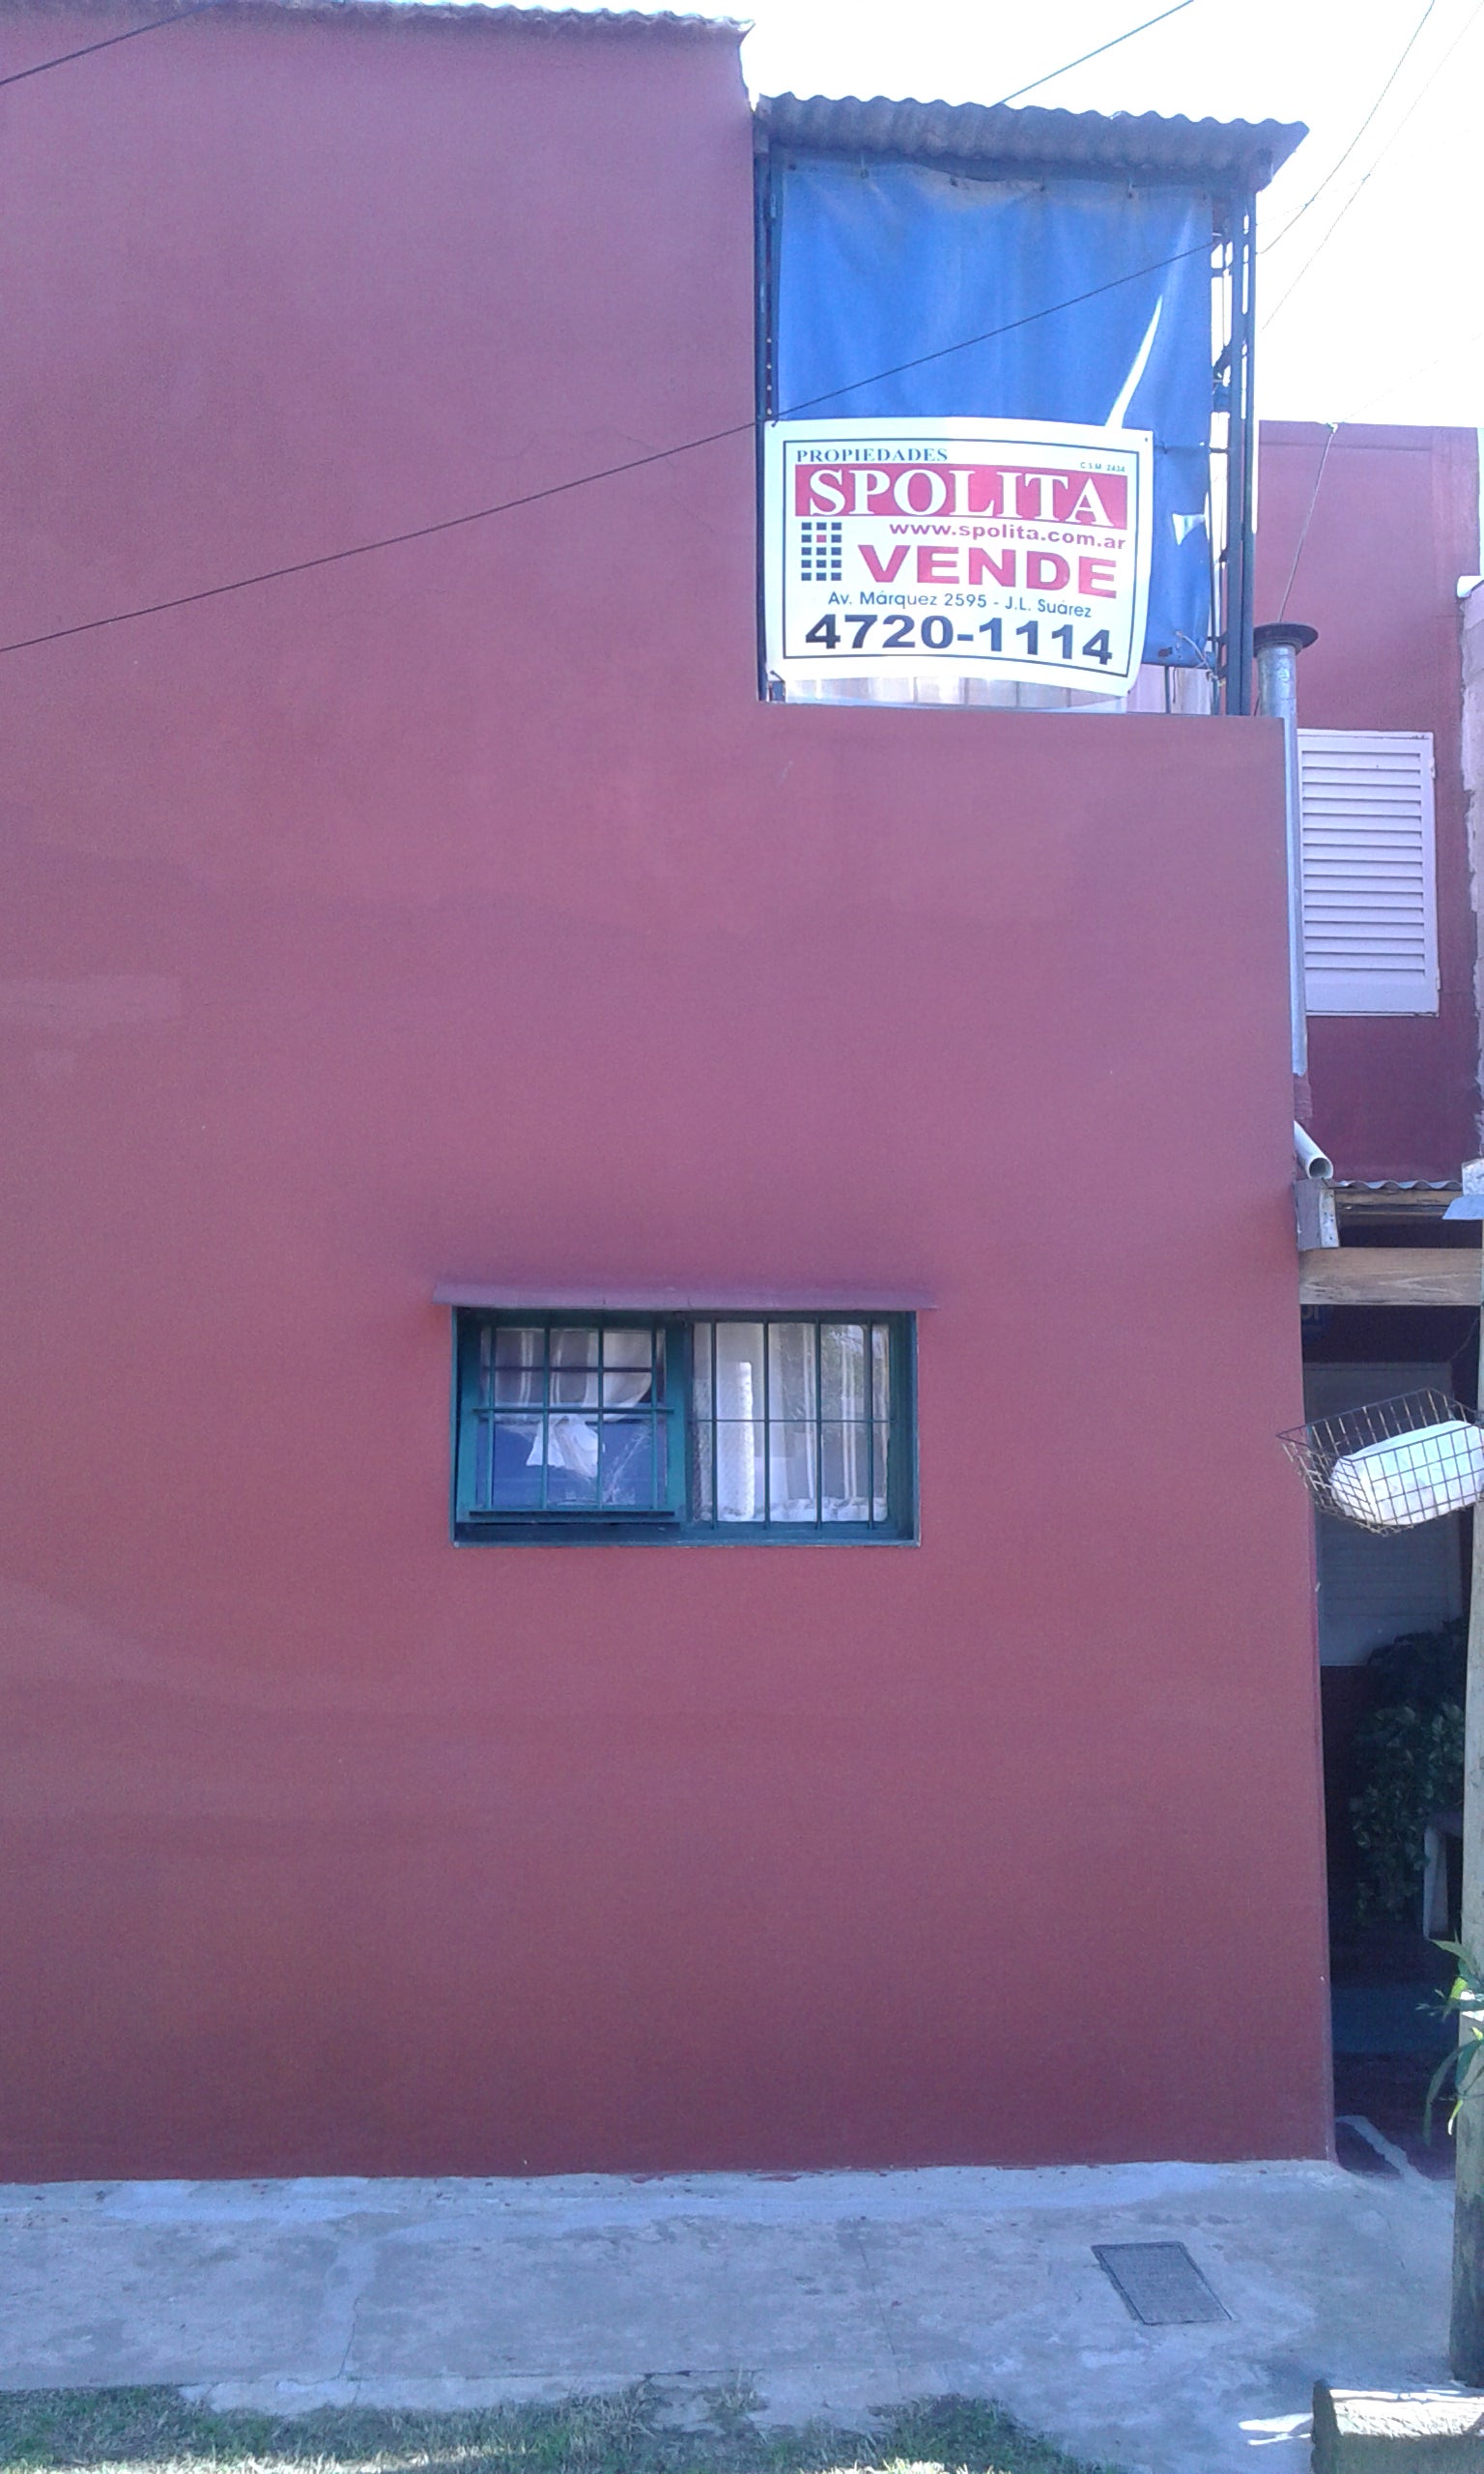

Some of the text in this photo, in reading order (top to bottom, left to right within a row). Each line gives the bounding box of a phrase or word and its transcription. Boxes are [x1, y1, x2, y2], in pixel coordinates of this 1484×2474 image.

[796, 447, 949, 463] PROPIEDADES
[809, 469, 1115, 528] SPOLITA
[889, 523, 1127, 550] www.spolita.com.ar
[857, 544, 1117, 599] VENDE
[828, 591, 852, 606] Av.
[860, 590, 938, 608] Márquez
[944, 594, 987, 608] 2595
[1005, 596, 1032, 612] J.L.
[805, 614, 1113, 665] 4720-1114
